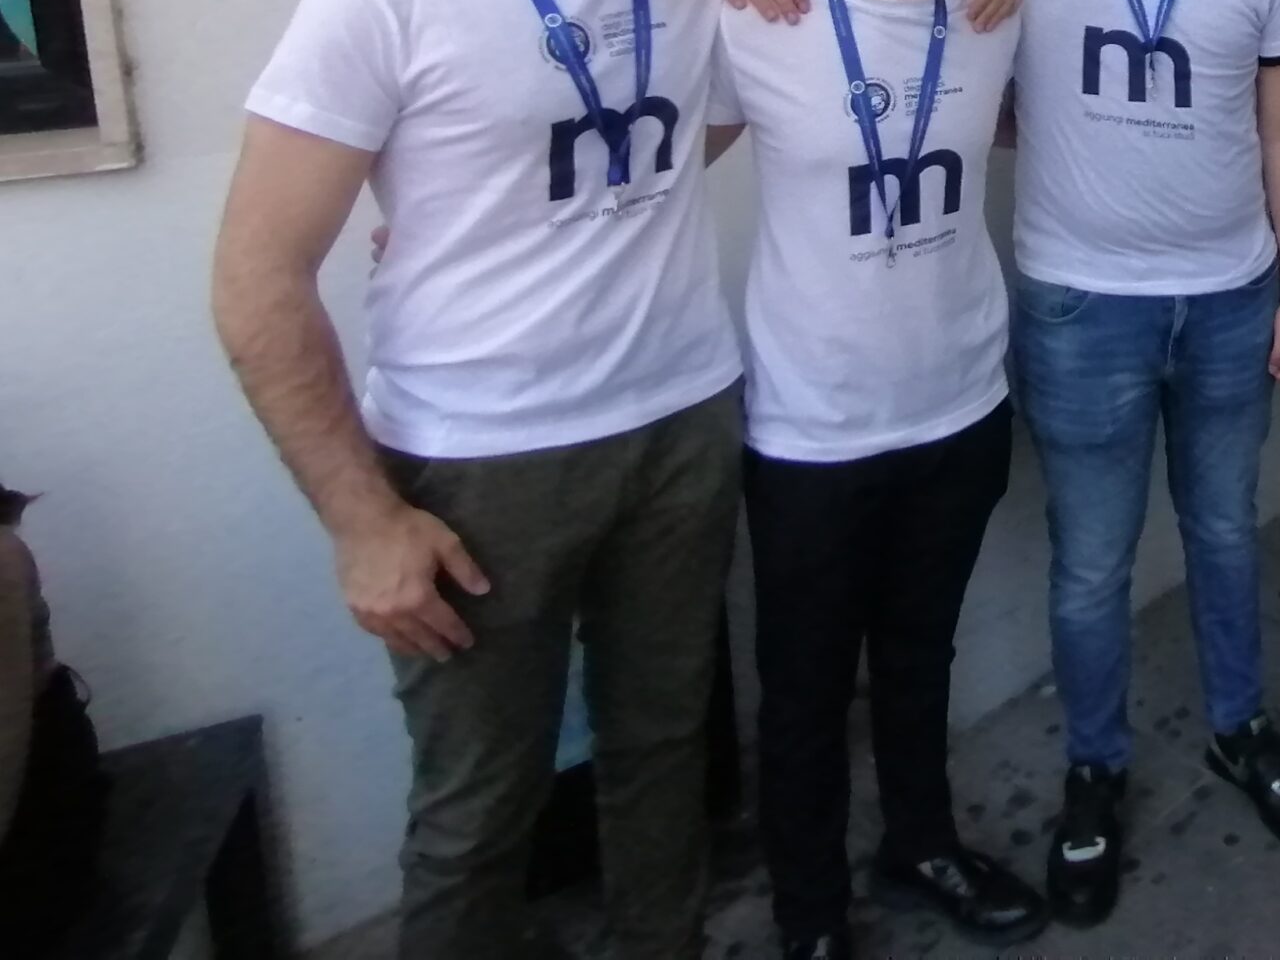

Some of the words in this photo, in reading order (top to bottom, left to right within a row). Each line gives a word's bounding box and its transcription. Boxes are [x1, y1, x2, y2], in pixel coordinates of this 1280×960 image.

[1081, 25, 1193, 108] m
[1125, 117, 1195, 131] mediterranea
[848, 148, 964, 237] m
